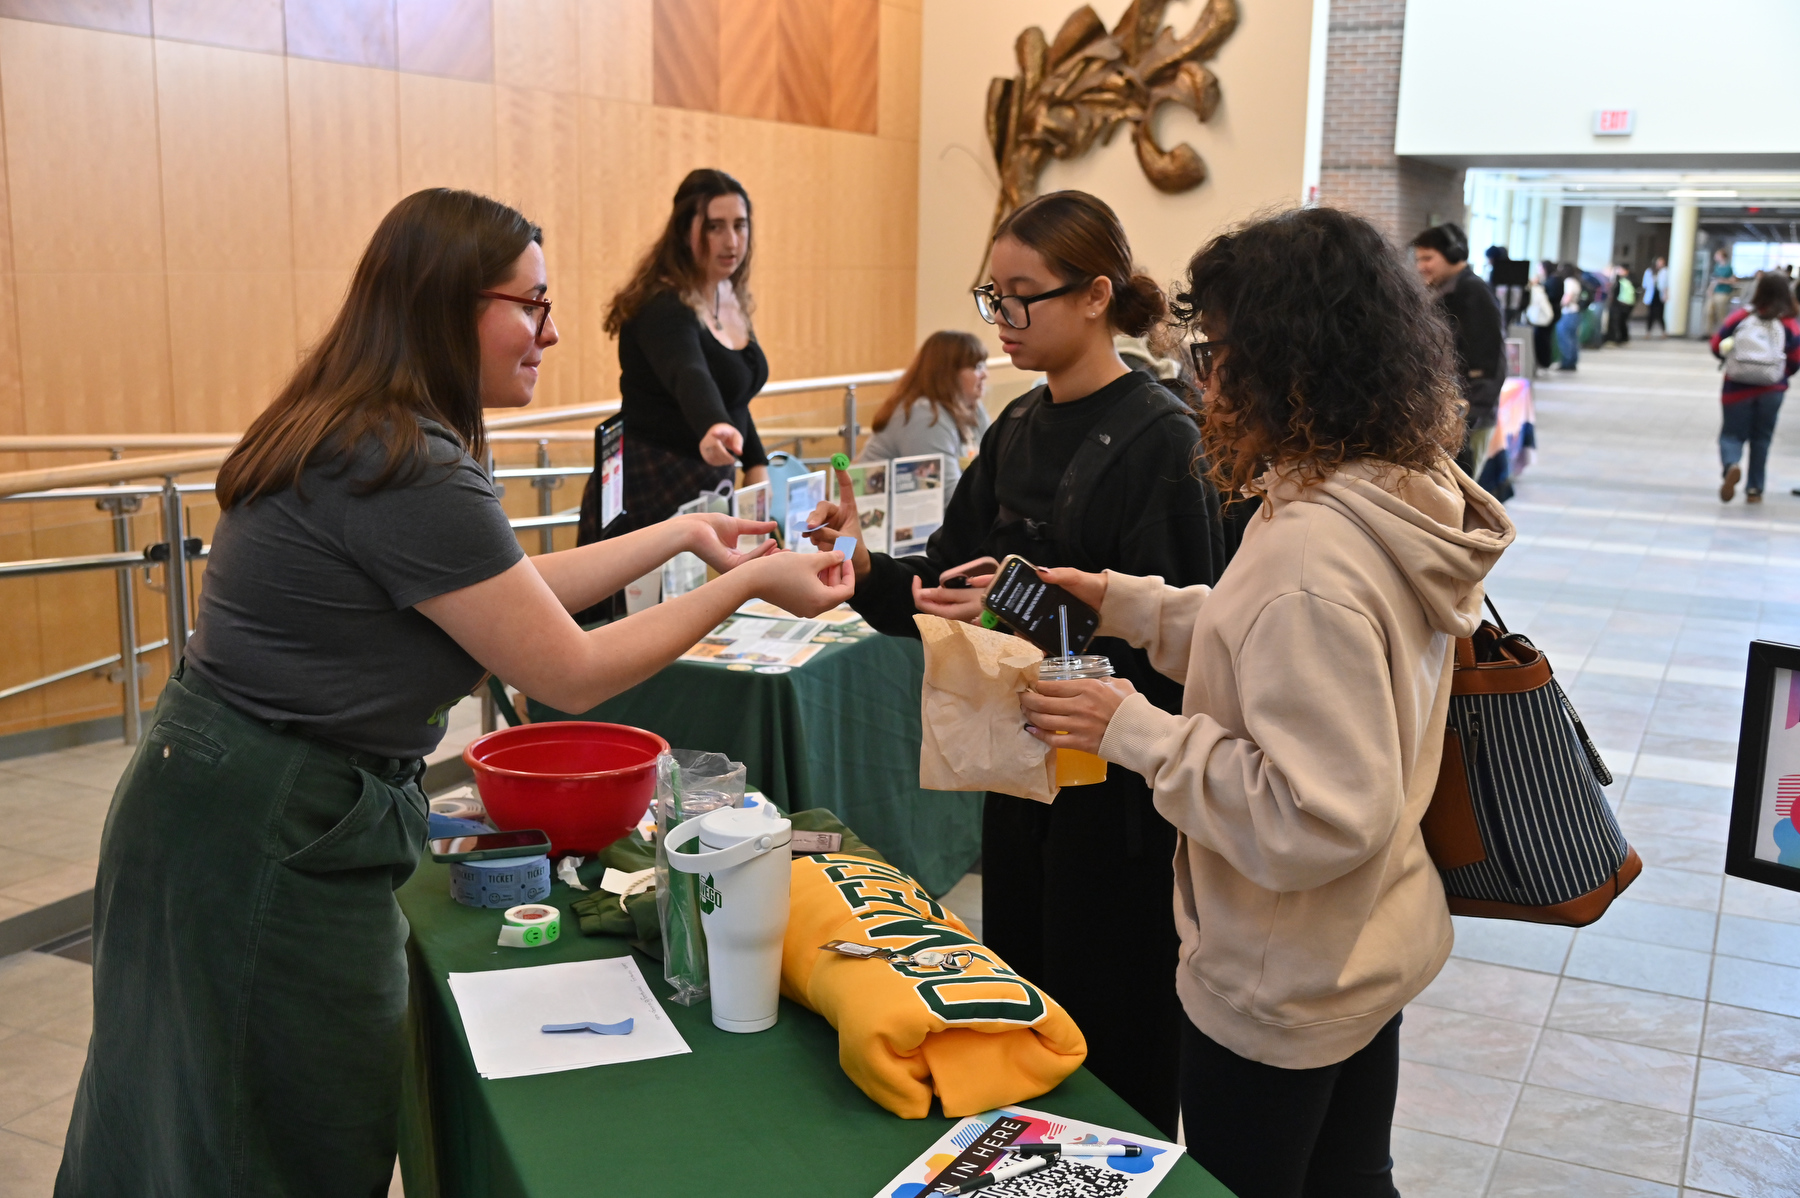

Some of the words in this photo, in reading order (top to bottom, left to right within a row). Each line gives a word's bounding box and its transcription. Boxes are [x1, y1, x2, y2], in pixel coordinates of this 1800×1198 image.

[1601, 110, 1628, 130] EXIT
[1562, 697, 1580, 723] OSWEGO
[488, 874, 514, 884] TICKET
[526, 866, 545, 880] TICKET
[950, 1161, 979, 1179] IN
[972, 1120, 1022, 1158] HERE
